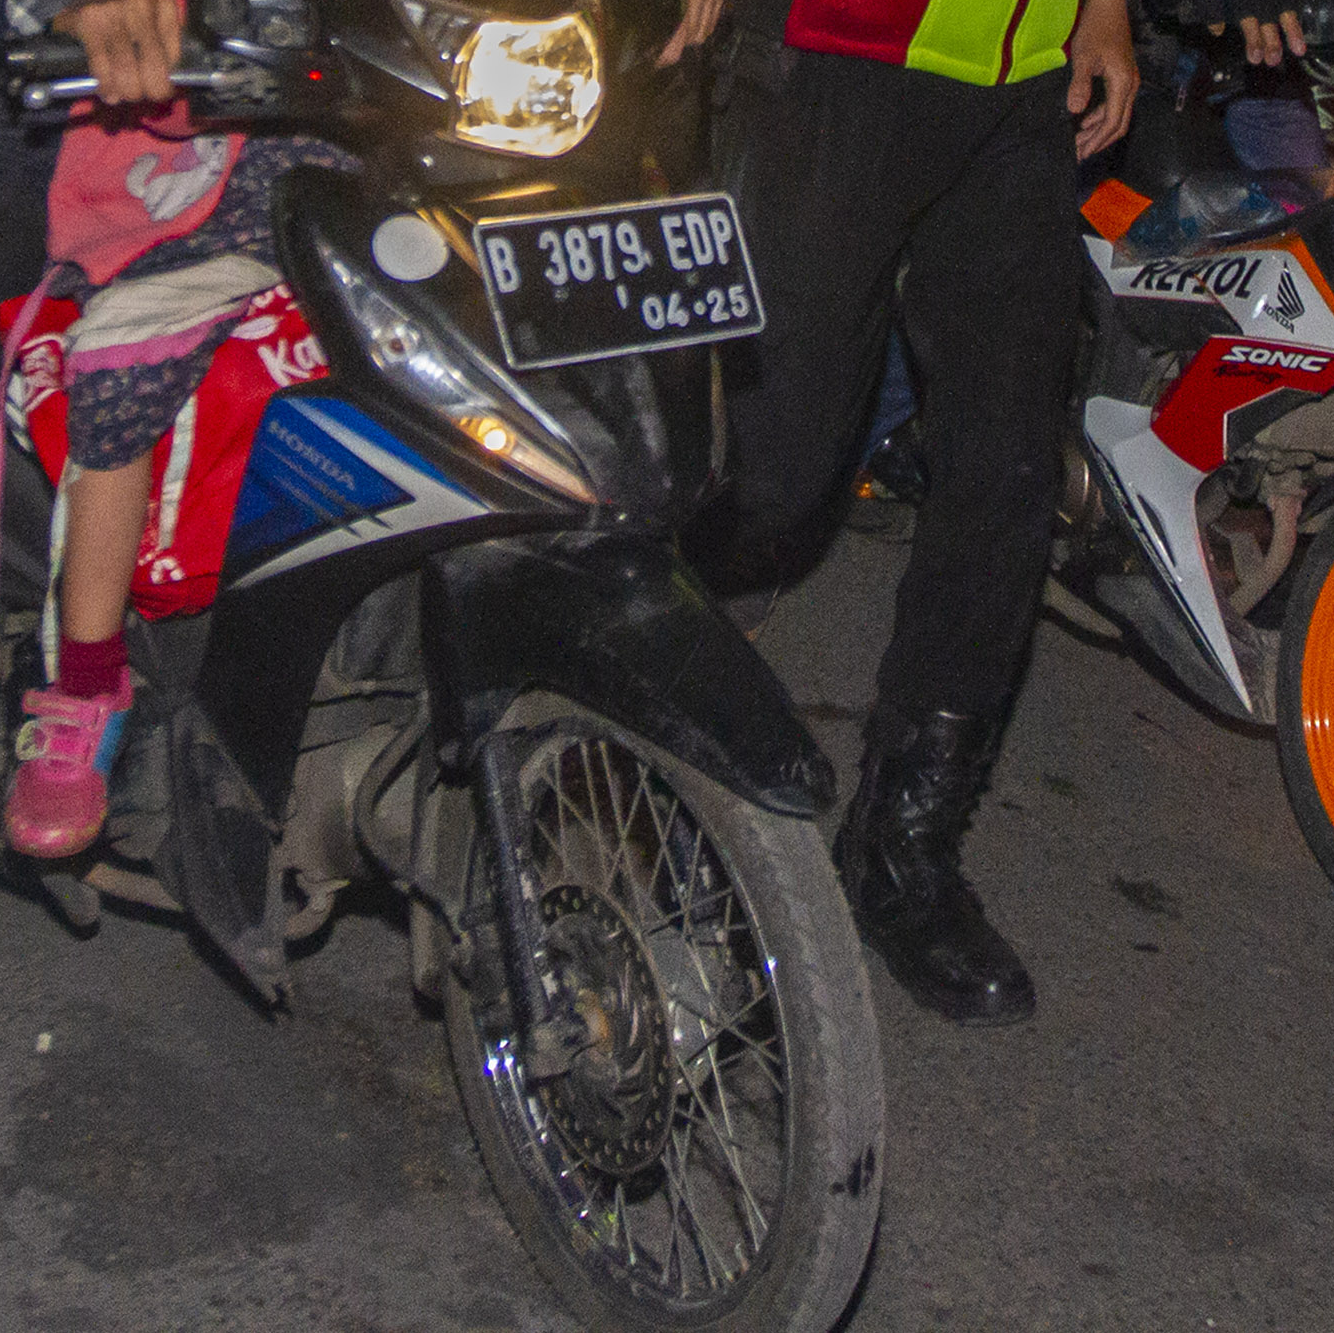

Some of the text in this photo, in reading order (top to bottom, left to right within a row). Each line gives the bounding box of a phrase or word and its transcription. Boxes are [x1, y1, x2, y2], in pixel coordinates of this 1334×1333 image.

[485, 210, 733, 294] B 3879 EDP
[1130, 256, 1263, 299] REPSOL
[1221, 345, 1333, 373] SONIC
[267, 418, 357, 492] HONDA
